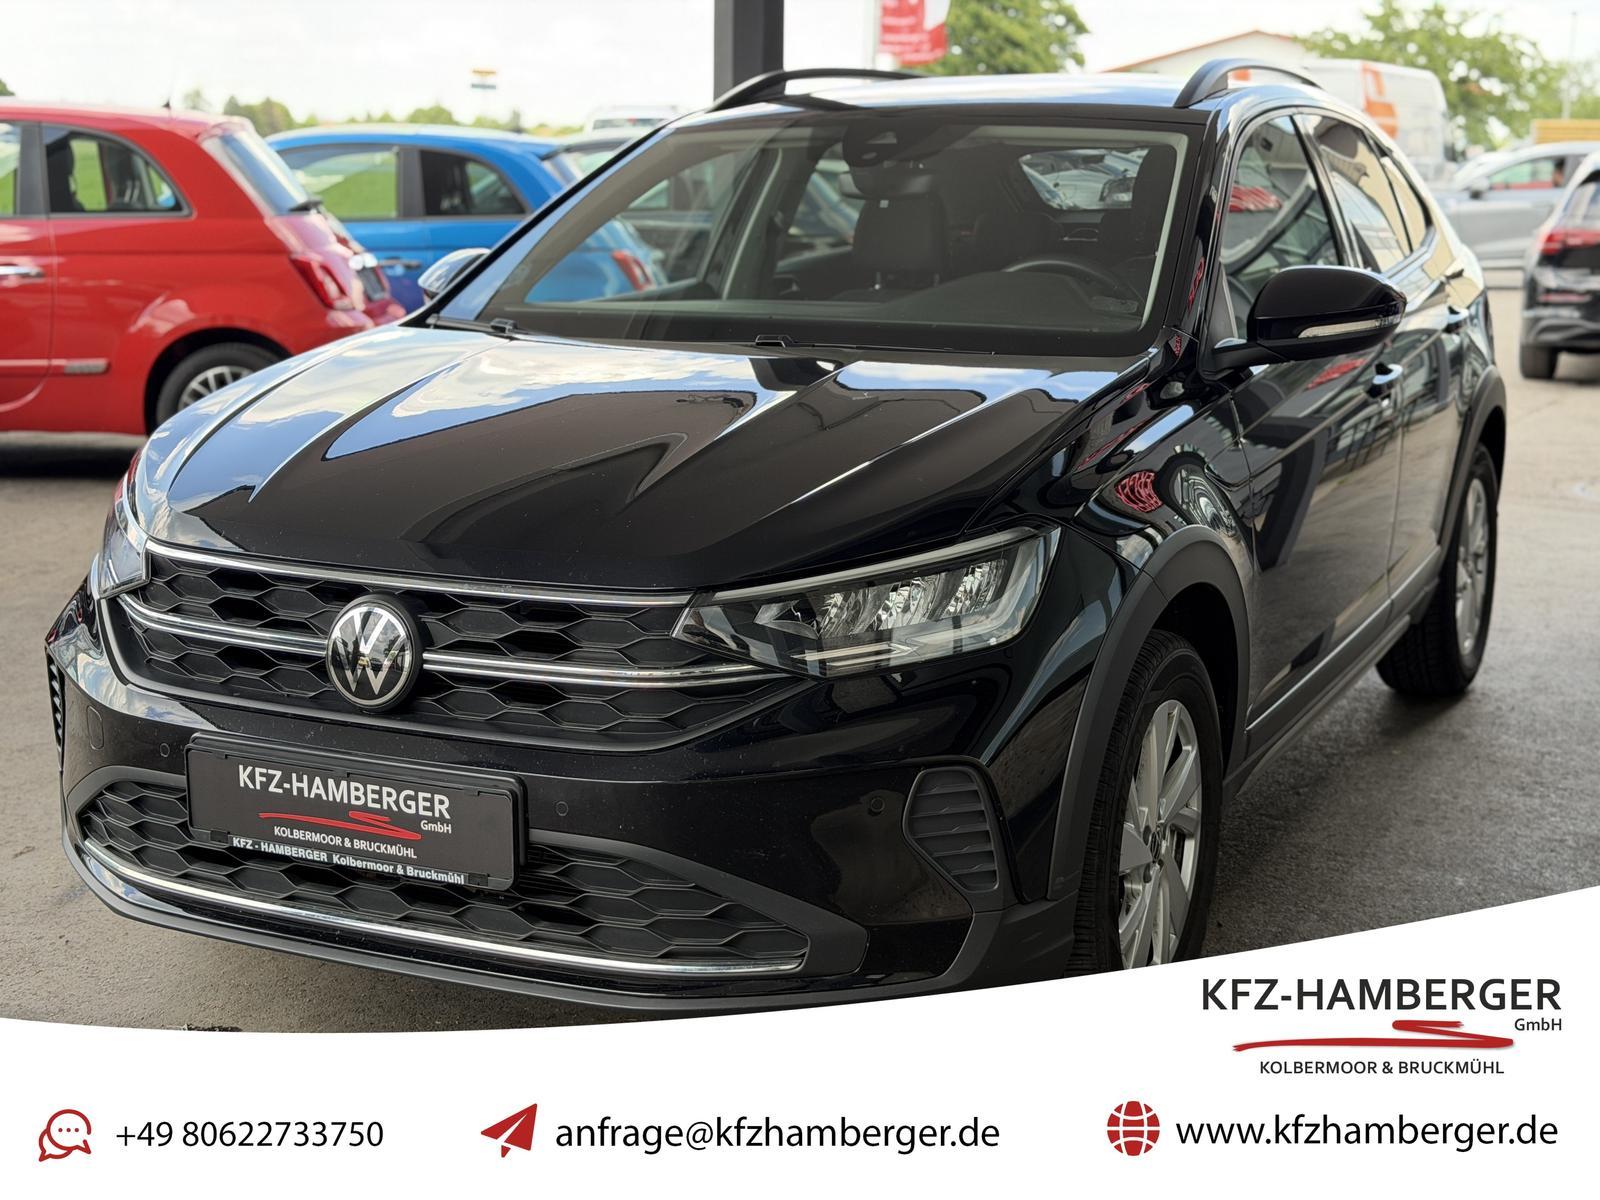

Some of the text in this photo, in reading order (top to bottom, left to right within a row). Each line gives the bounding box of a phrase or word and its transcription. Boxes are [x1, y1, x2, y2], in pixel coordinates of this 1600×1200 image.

[331, 606, 411, 702] VW
[238, 764, 451, 819] KFZ-HAMBERGER
[274, 826, 417, 859] KOLBERMOOR & BRUCKMÜHL
[421, 821, 452, 834] GmbH
[233, 837, 253, 850] KFZ
[261, 842, 328, 863] HAMBERGER
[333, 854, 394, 873] Kolbermoor
[396, 864, 405, 875] &
[406, 866, 465, 884] Bruckmühl
